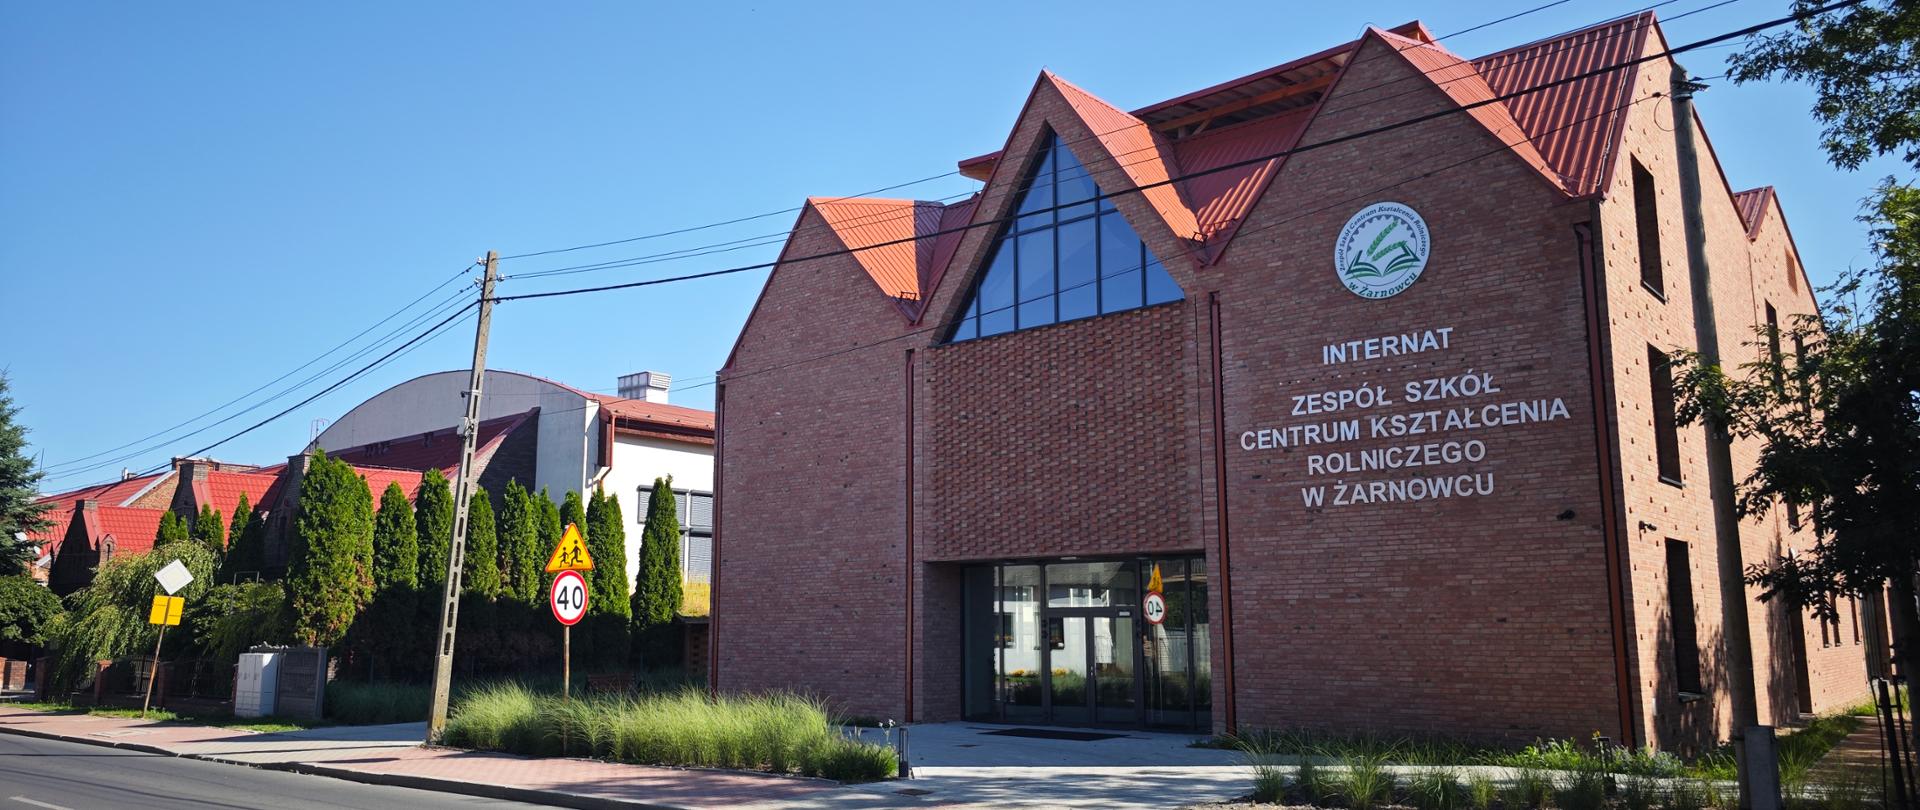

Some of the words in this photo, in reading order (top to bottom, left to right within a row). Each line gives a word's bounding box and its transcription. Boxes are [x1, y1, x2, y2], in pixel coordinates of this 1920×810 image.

[1350, 209, 1377, 230] Centrum
[1348, 282, 1359, 291] w
[1358, 272, 1418, 298] Żarnowcu
[1322, 327, 1453, 366] INTERNAT
[1291, 382, 1393, 416] ZESPÓŁ
[1404, 368, 1501, 403] SZKÓŁ
[1240, 419, 1360, 451] CENTRUM
[1370, 397, 1571, 439] KSZTAŁCENIA
[1307, 439, 1487, 476] ROLNICZEGO
[1301, 486, 1326, 508] W
[1333, 472, 1495, 507] ŻARNOWCU
[556, 585, 584, 611] 40
